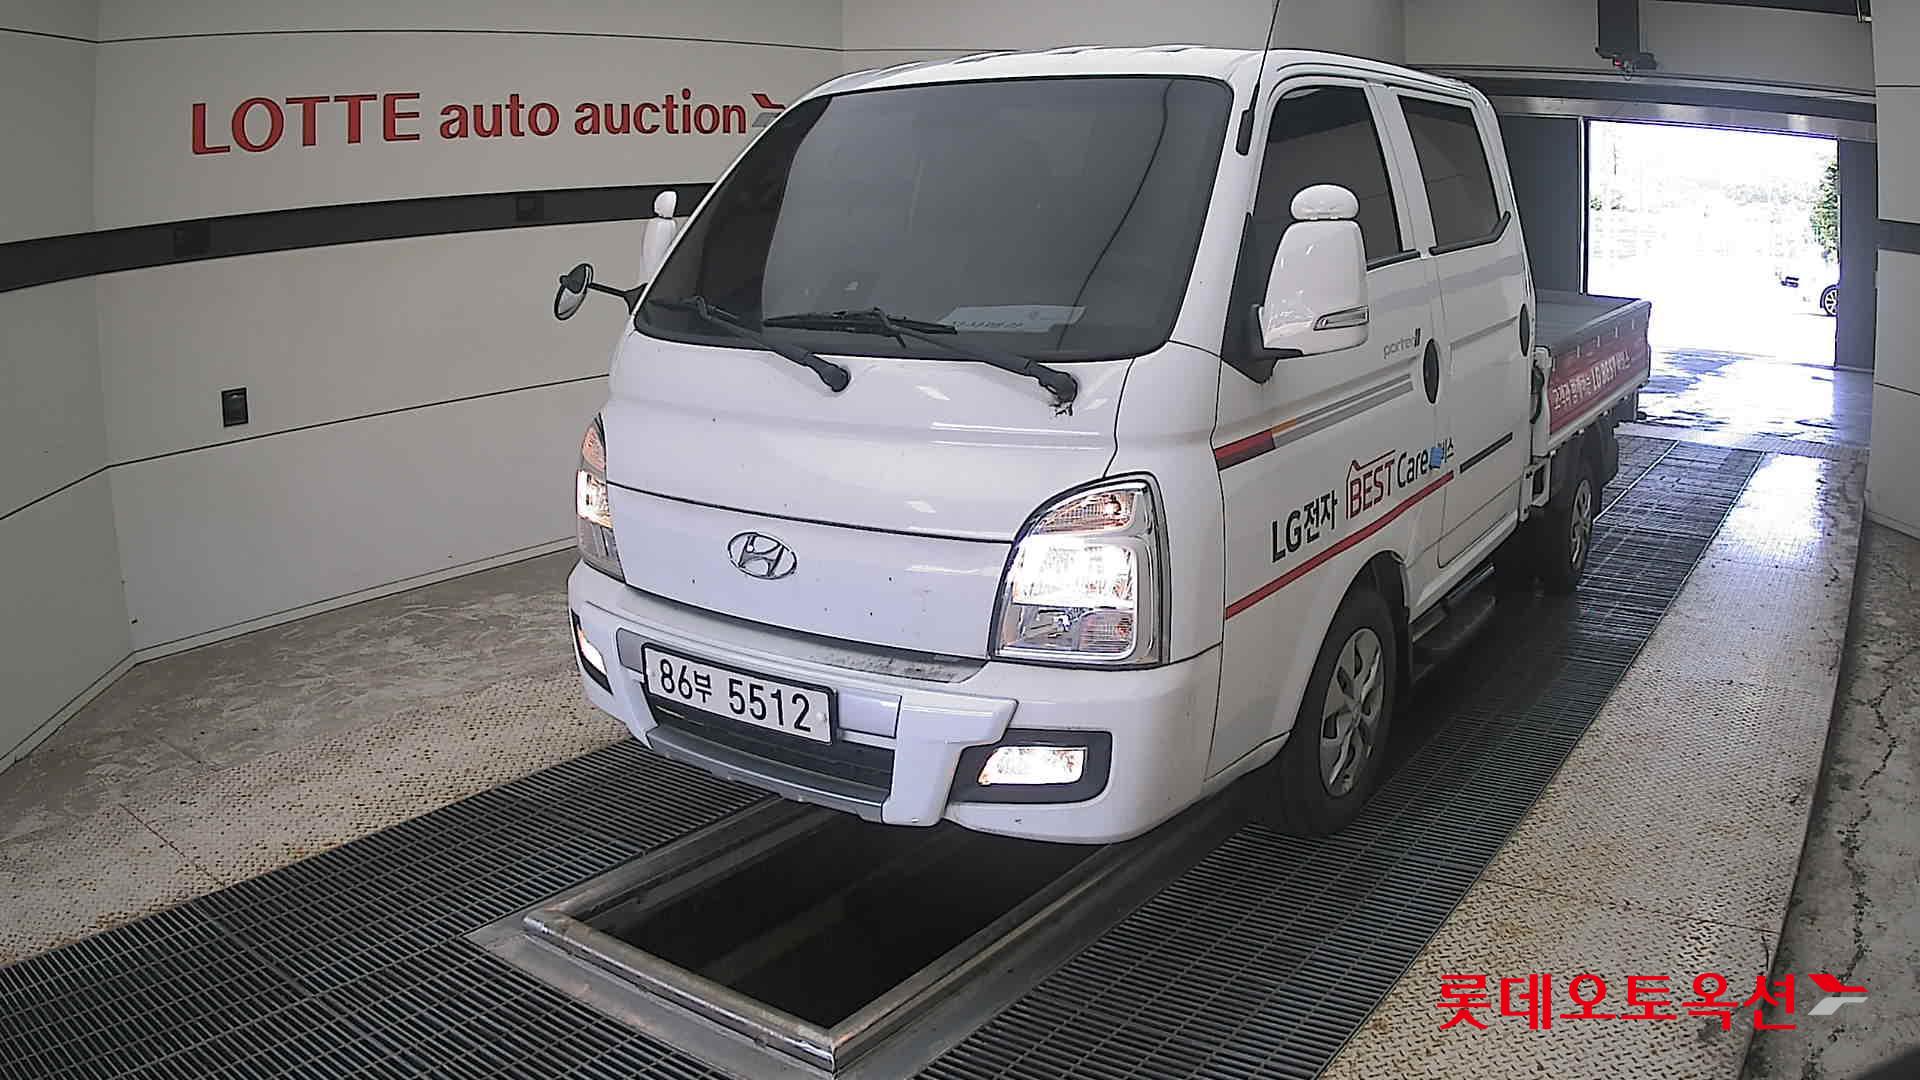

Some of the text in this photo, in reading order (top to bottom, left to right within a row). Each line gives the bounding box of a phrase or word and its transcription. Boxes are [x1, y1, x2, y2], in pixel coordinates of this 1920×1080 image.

[192, 88, 747, 155] LOTTE auto auction
[1272, 489, 1338, 563] LG전자
[1346, 458, 1395, 520] BEST
[1397, 451, 1429, 488] Care
[660, 658, 811, 733] 86부 5512
